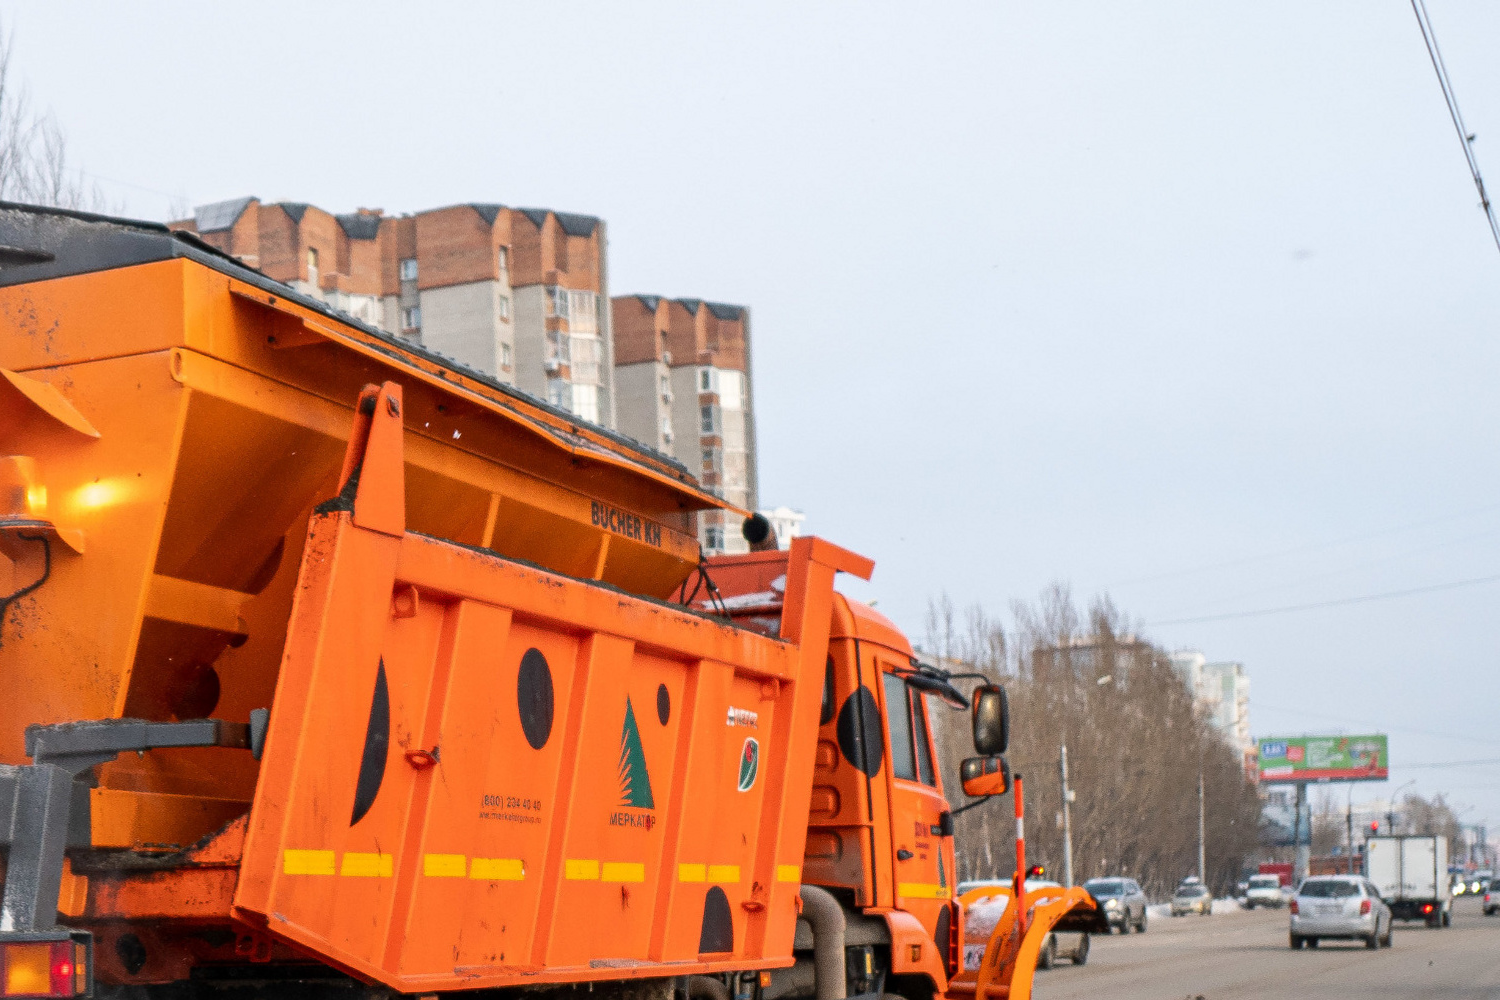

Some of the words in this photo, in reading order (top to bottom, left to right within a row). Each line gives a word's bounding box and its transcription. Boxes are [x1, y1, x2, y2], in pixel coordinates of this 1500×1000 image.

[591, 501, 642, 541] BUCHER
[481, 794, 504, 810] (800)
[506, 796, 521, 809] 234
[522, 798, 531, 811] 40
[533, 799, 542, 812] 40
